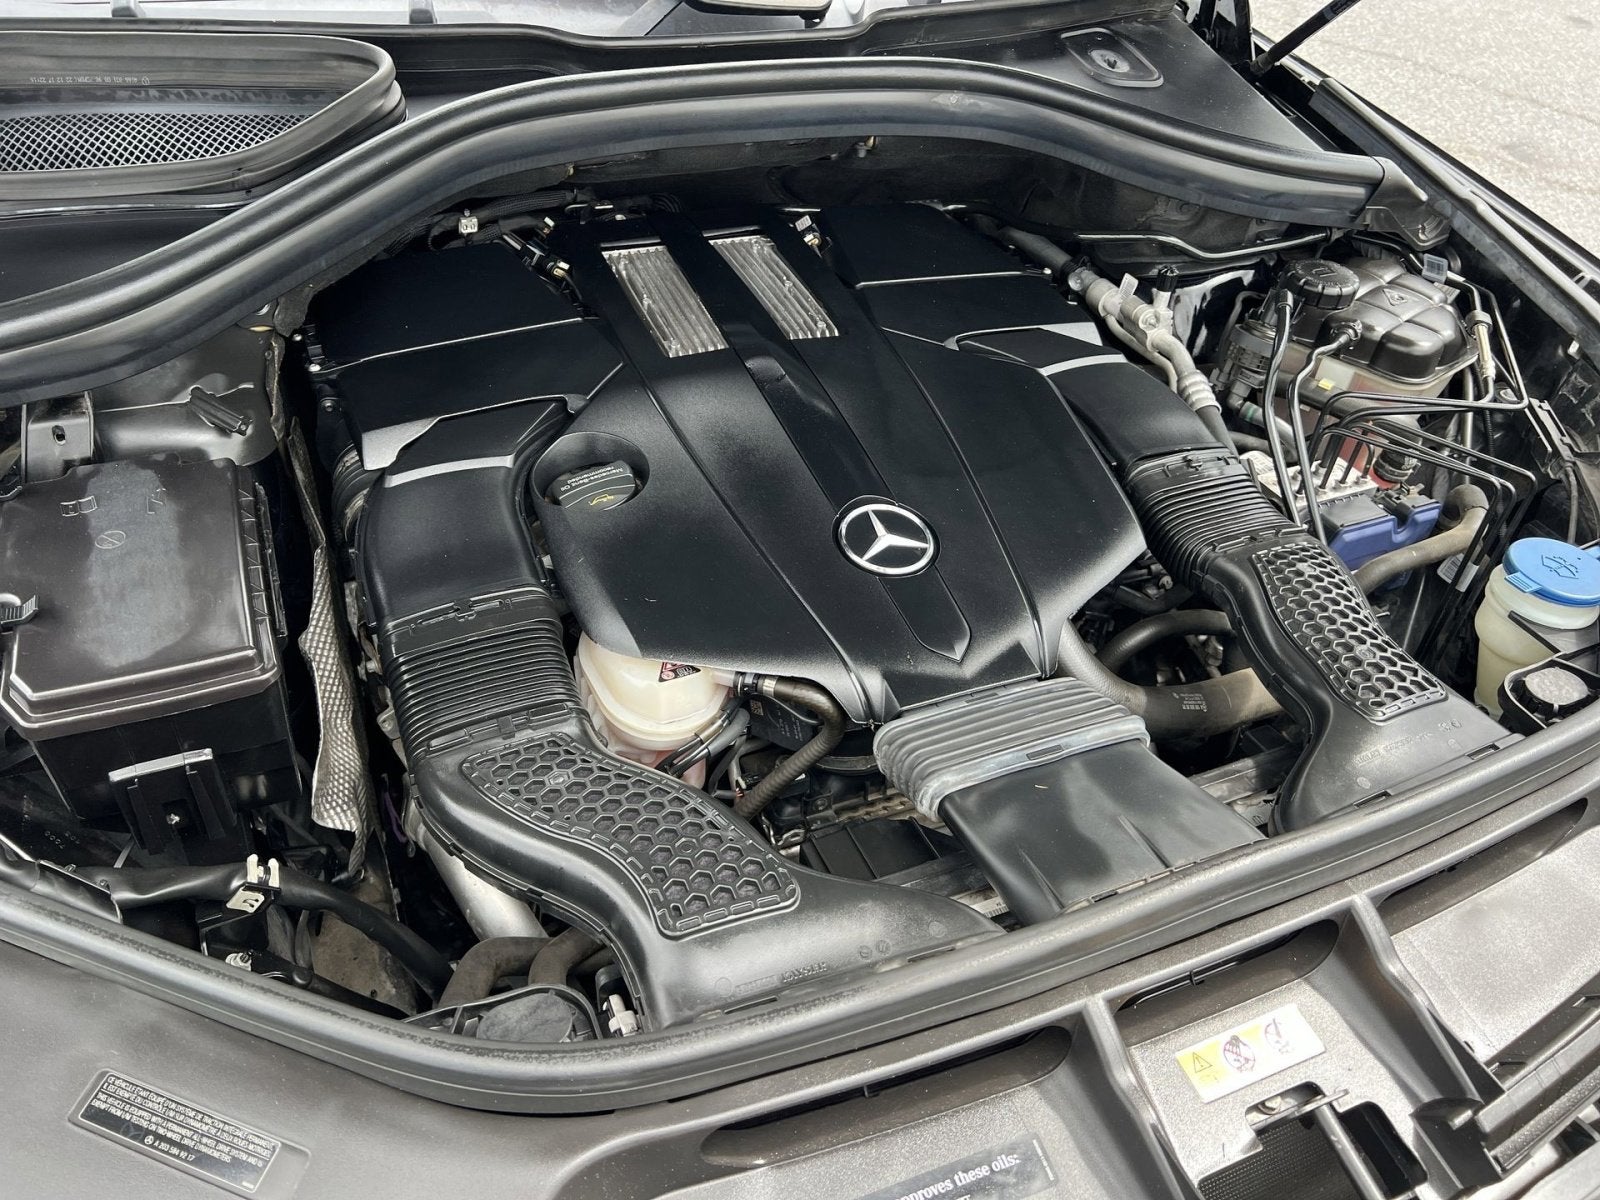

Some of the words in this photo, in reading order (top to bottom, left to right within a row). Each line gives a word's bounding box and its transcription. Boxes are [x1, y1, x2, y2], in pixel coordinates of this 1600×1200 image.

[567, 466, 614, 484] recommended
[571, 467, 624, 487] Mercedes-Benz
[895, 1179, 954, 1200] proves
[953, 1164, 991, 1186] these
[991, 1154, 1021, 1172] oils:
